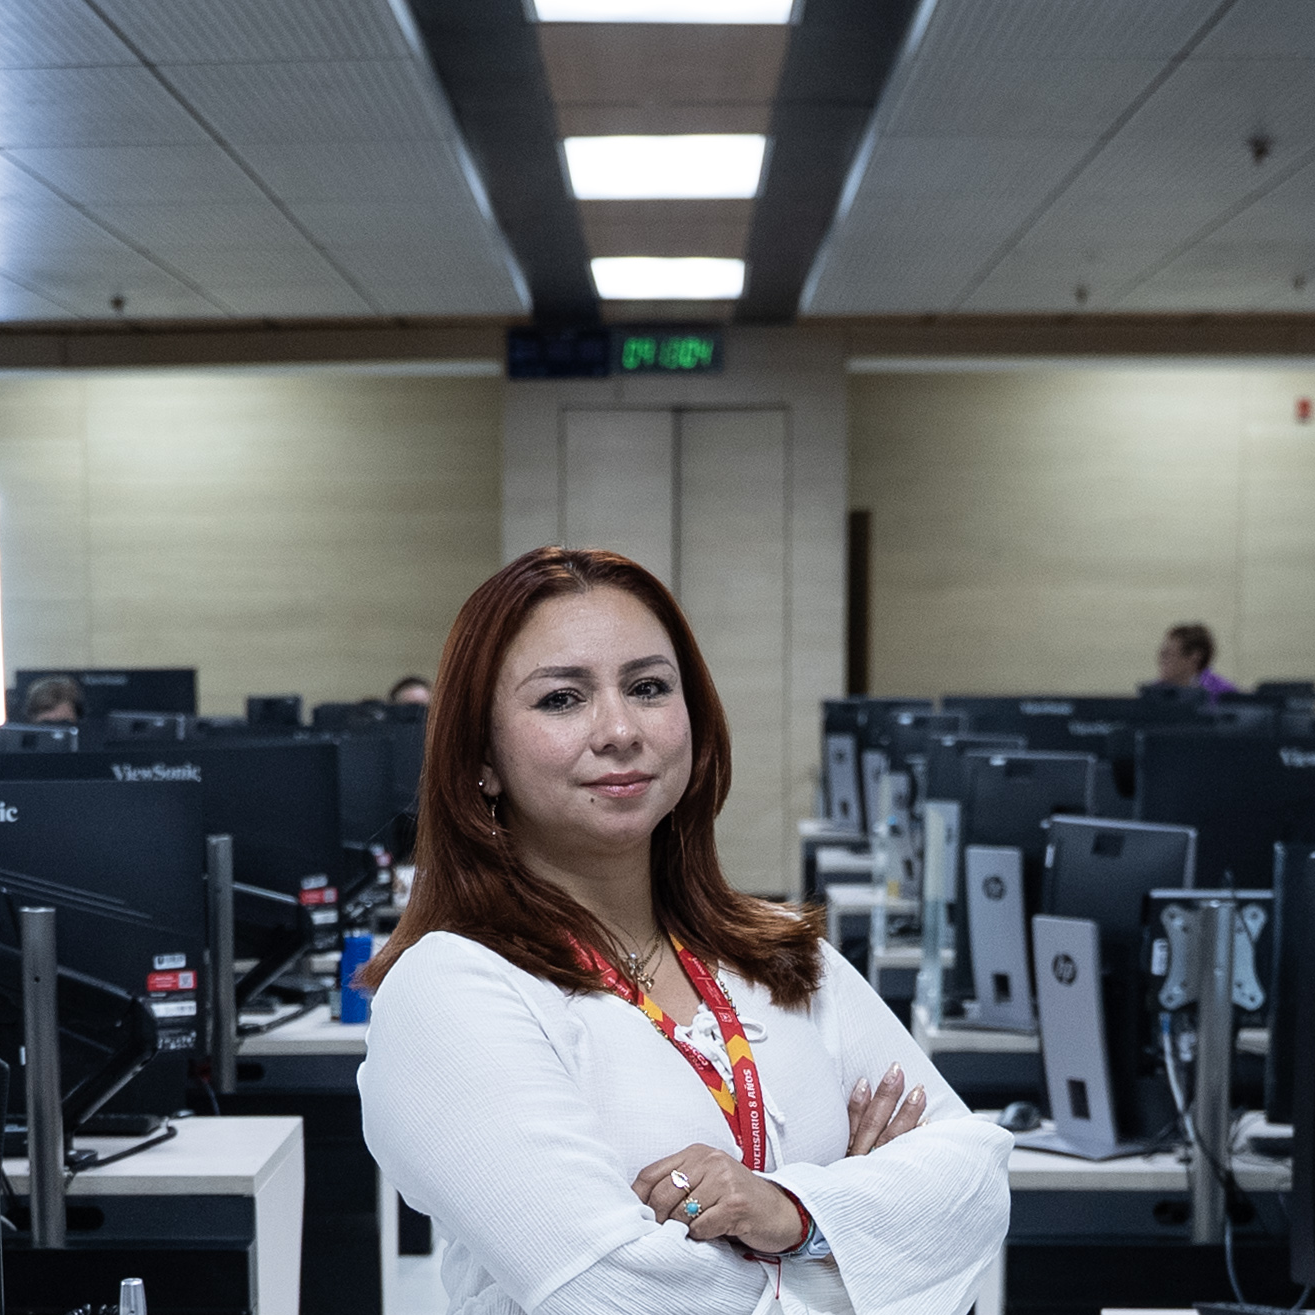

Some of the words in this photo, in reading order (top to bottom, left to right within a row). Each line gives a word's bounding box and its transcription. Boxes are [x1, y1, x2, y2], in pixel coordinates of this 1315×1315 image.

[112, 763, 201, 781] ViewSonic
[743, 1068, 756, 1099] AÑOS
[748, 1100, 758, 1108] 8
